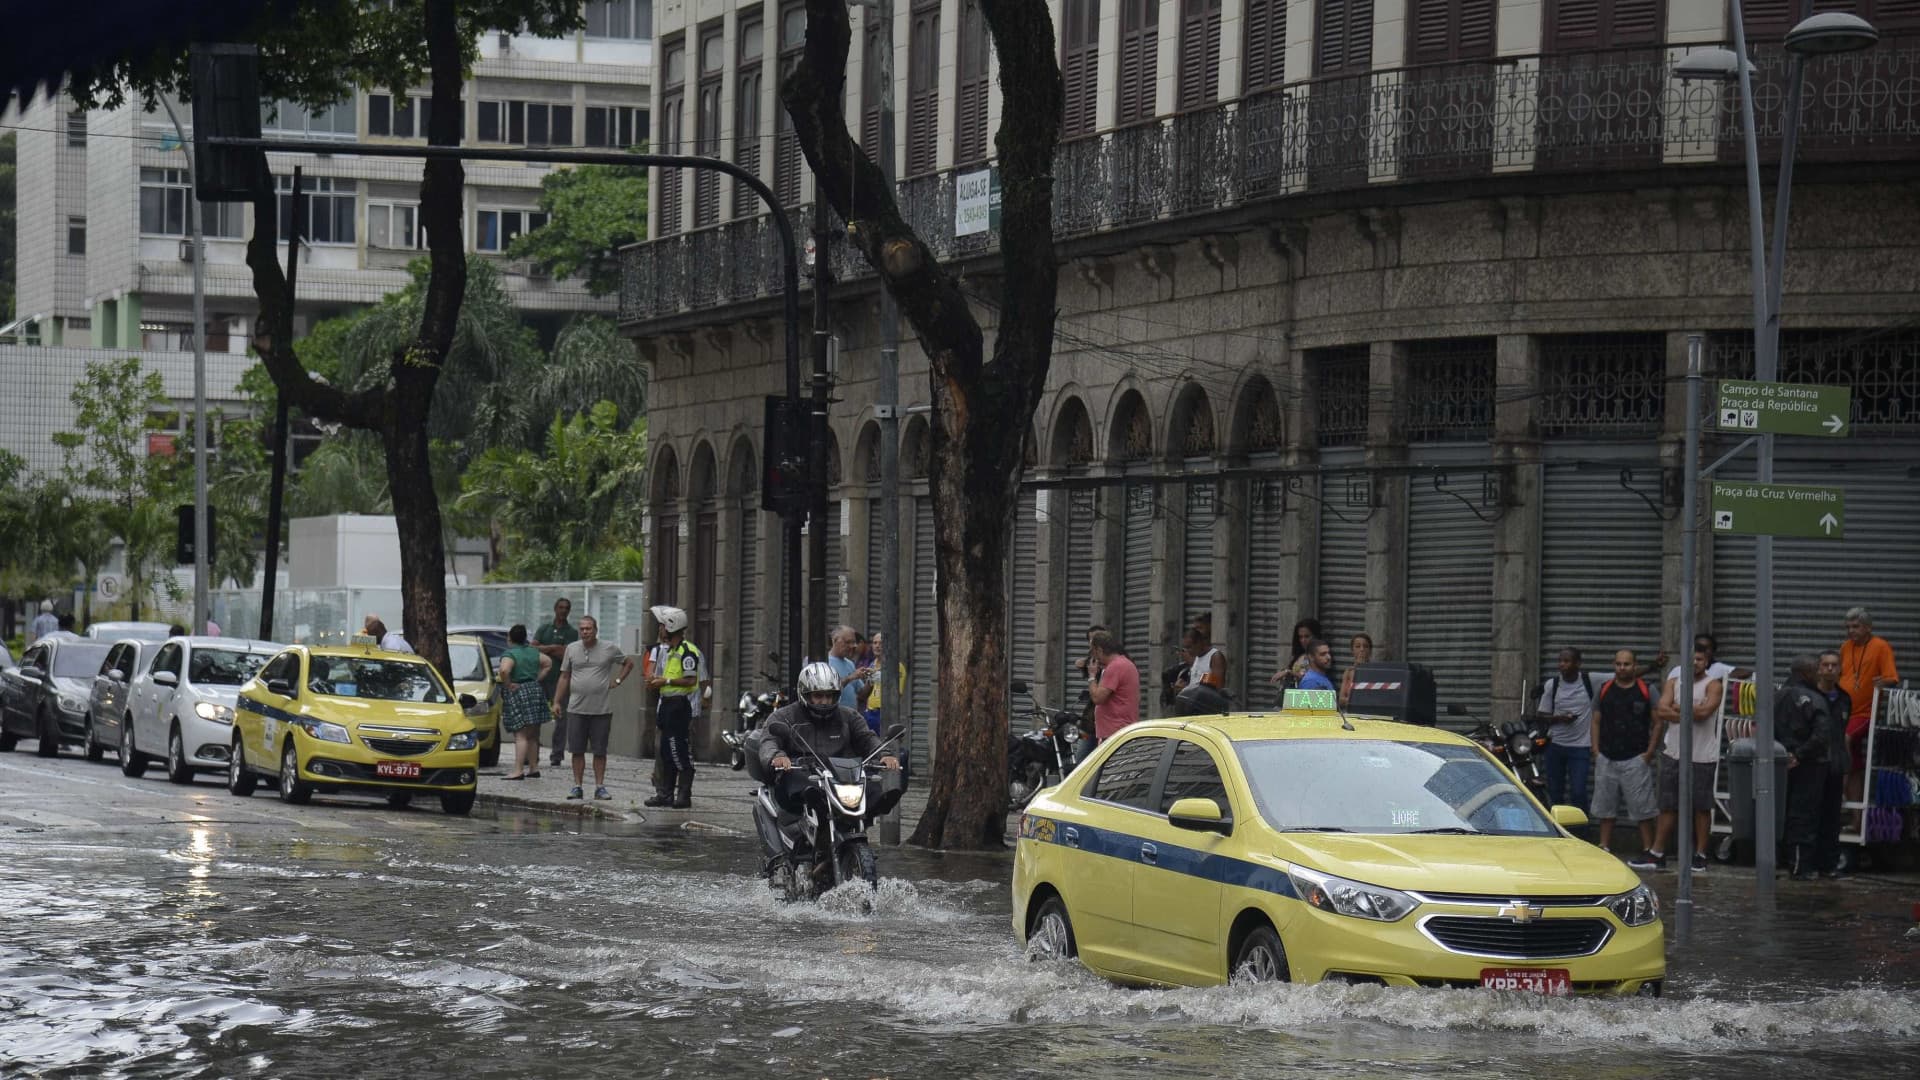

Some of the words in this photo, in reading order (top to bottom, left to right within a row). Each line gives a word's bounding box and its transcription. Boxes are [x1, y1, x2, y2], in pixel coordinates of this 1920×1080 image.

[960, 178, 987, 201] ALUGA-SE
[1721, 383, 1759, 397] Campo
[1761, 386, 1775, 397] de
[1777, 386, 1818, 399] Santana
[1721, 397, 1749, 410] Praça
[1751, 399, 1765, 409] da
[1767, 399, 1818, 413] República
[1715, 485, 1743, 499] Praça
[1745, 487, 1759, 498] da
[1761, 488, 1785, 499] Cruz
[1787, 489, 1837, 502] Vermelha
[1286, 690, 1333, 709] TAXI
[377, 764, 420, 776] KYL-9713
